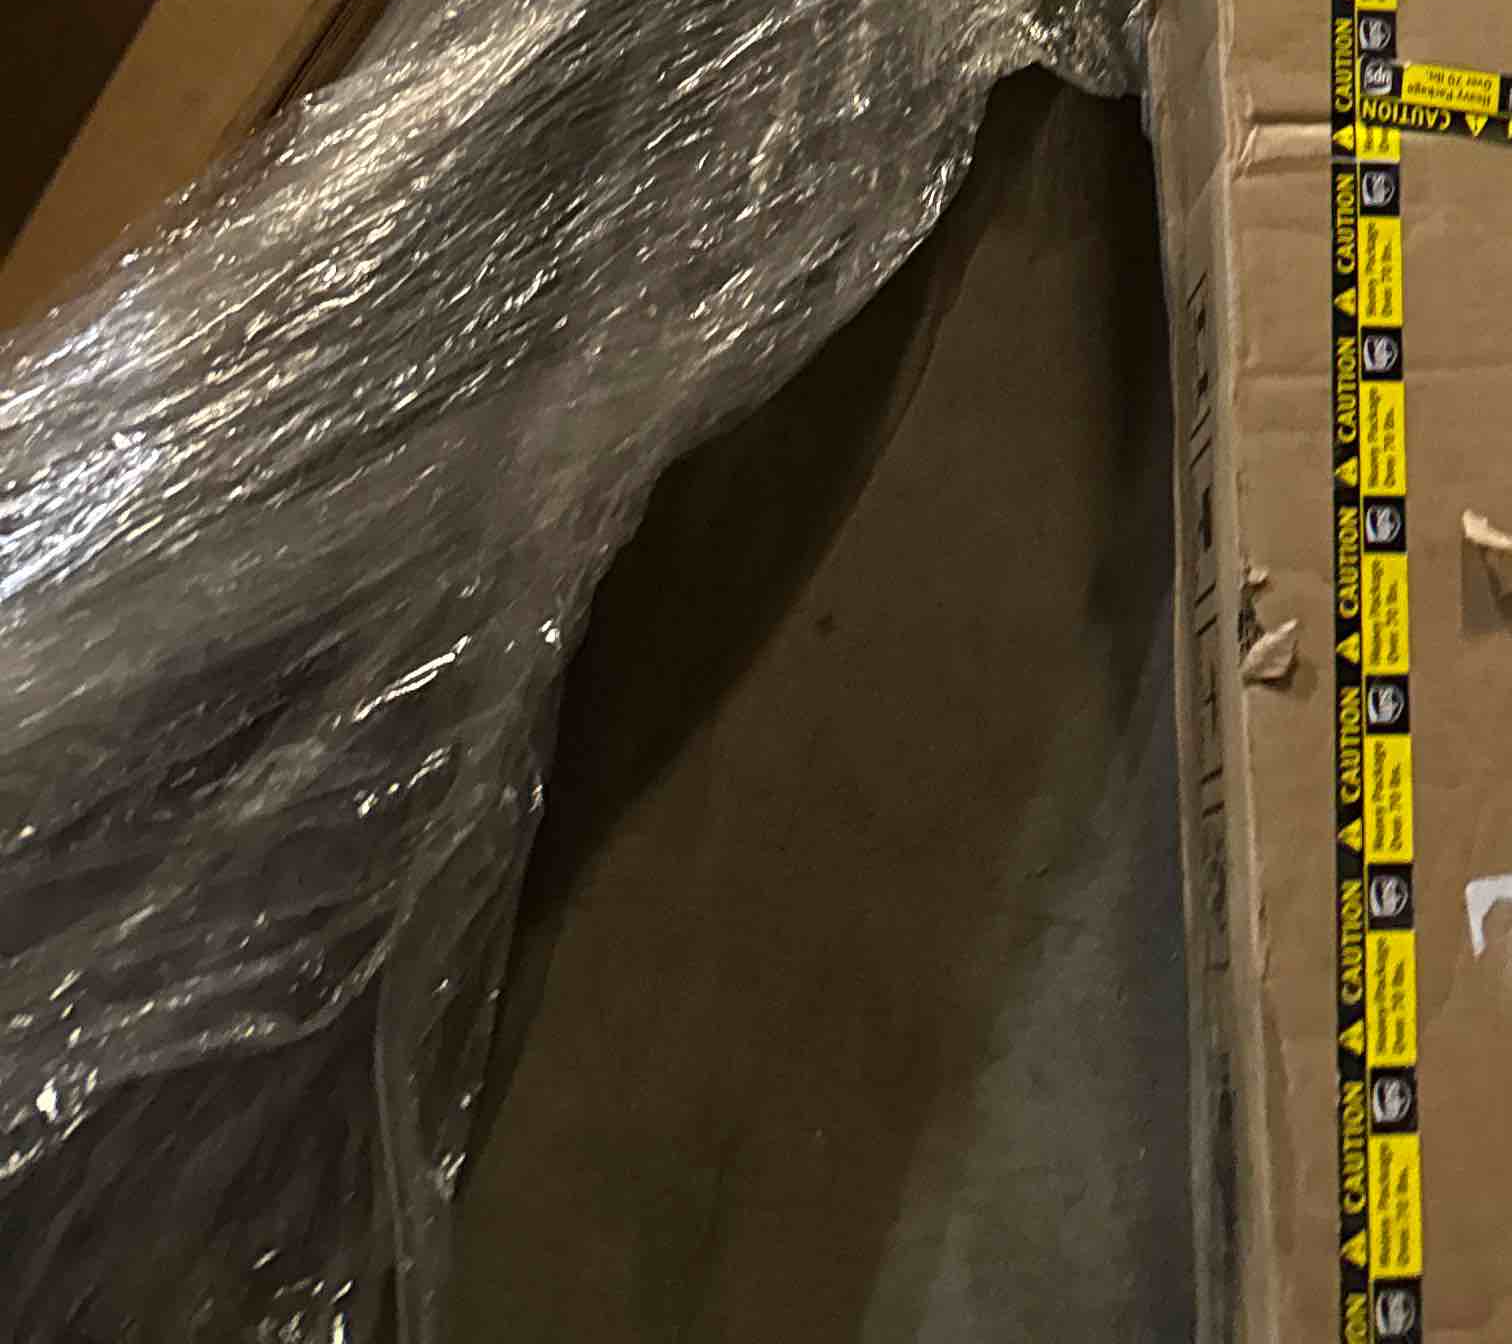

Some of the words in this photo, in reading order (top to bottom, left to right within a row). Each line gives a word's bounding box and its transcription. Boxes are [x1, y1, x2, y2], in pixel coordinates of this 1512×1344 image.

[1335, 18, 1353, 113] CAUTION
[1360, 98, 1450, 130] CAUTION
[1336, 173, 1356, 274] CAUTION
[1336, 336, 1357, 442] CAUTION
[1338, 506, 1360, 619] CAUTION
[1340, 687, 1362, 804] CAUTION
[1341, 879, 1364, 1005] CAUTION
[1343, 1081, 1365, 1216] CAUTION
